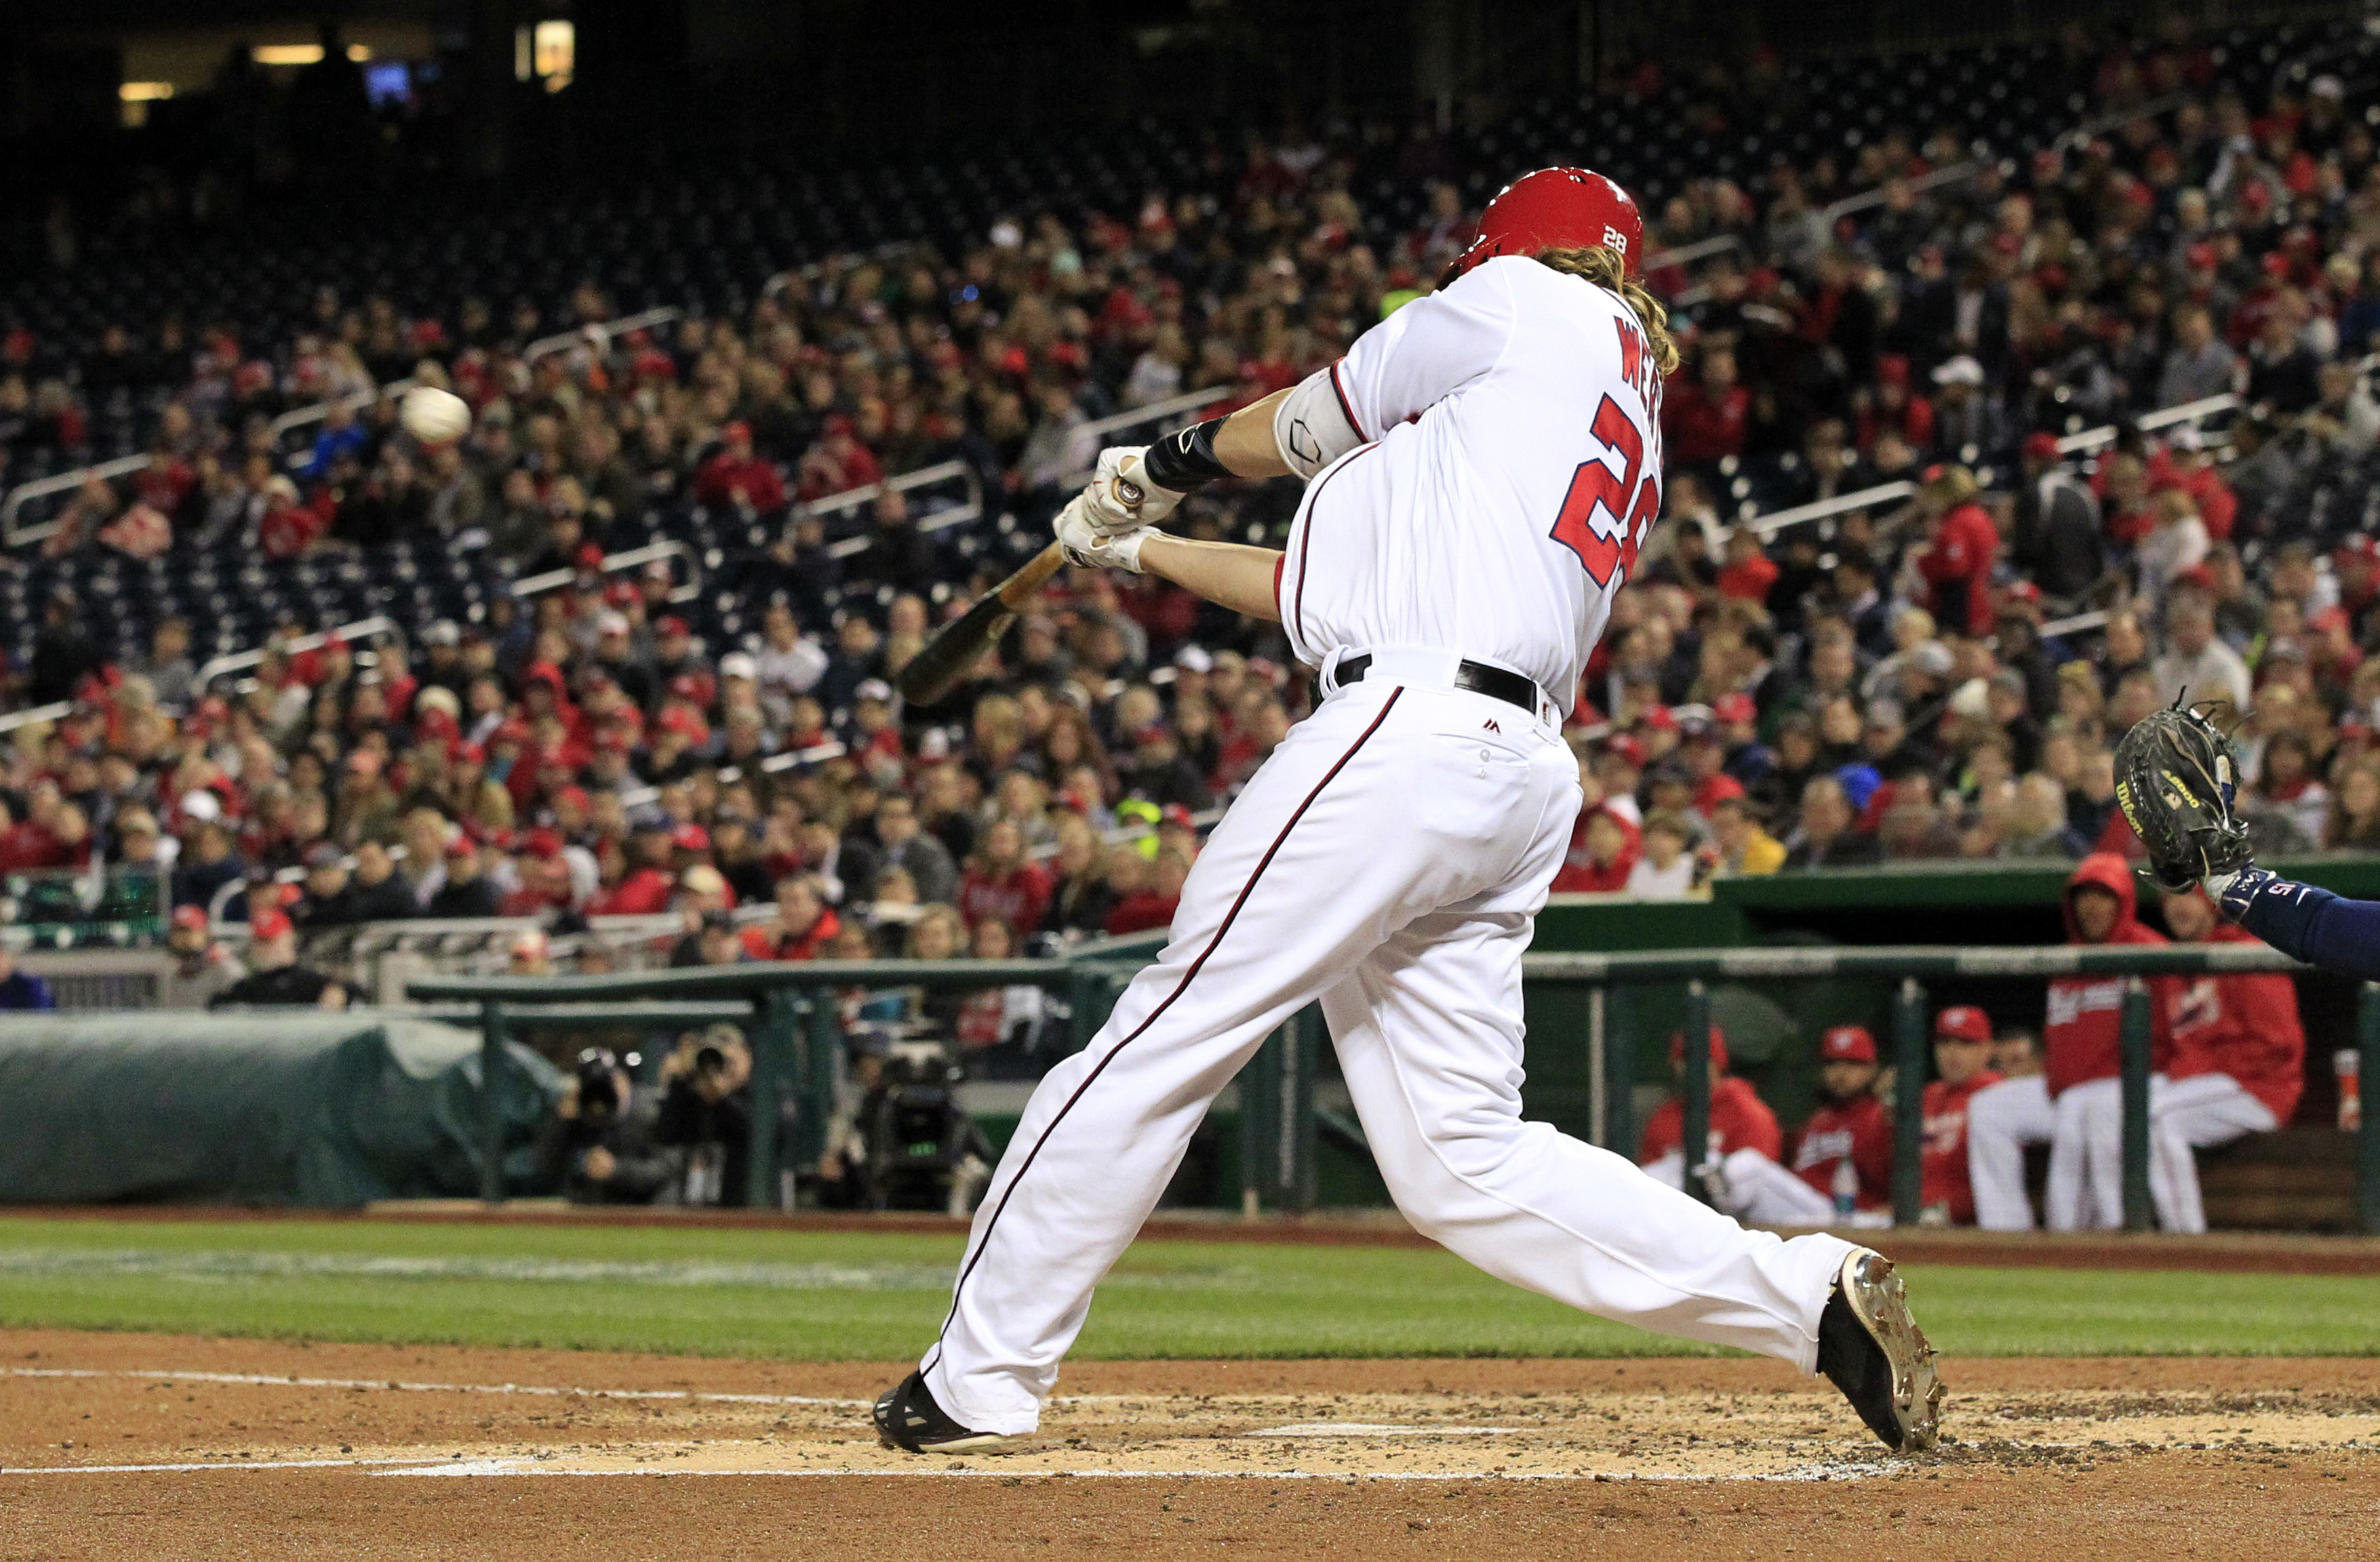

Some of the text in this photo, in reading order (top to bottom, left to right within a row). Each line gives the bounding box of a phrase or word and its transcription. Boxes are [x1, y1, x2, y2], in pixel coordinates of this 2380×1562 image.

[1602, 224, 1627, 254] 28
[2116, 781, 2143, 837] Wilson
[2268, 883, 2296, 896] 15
